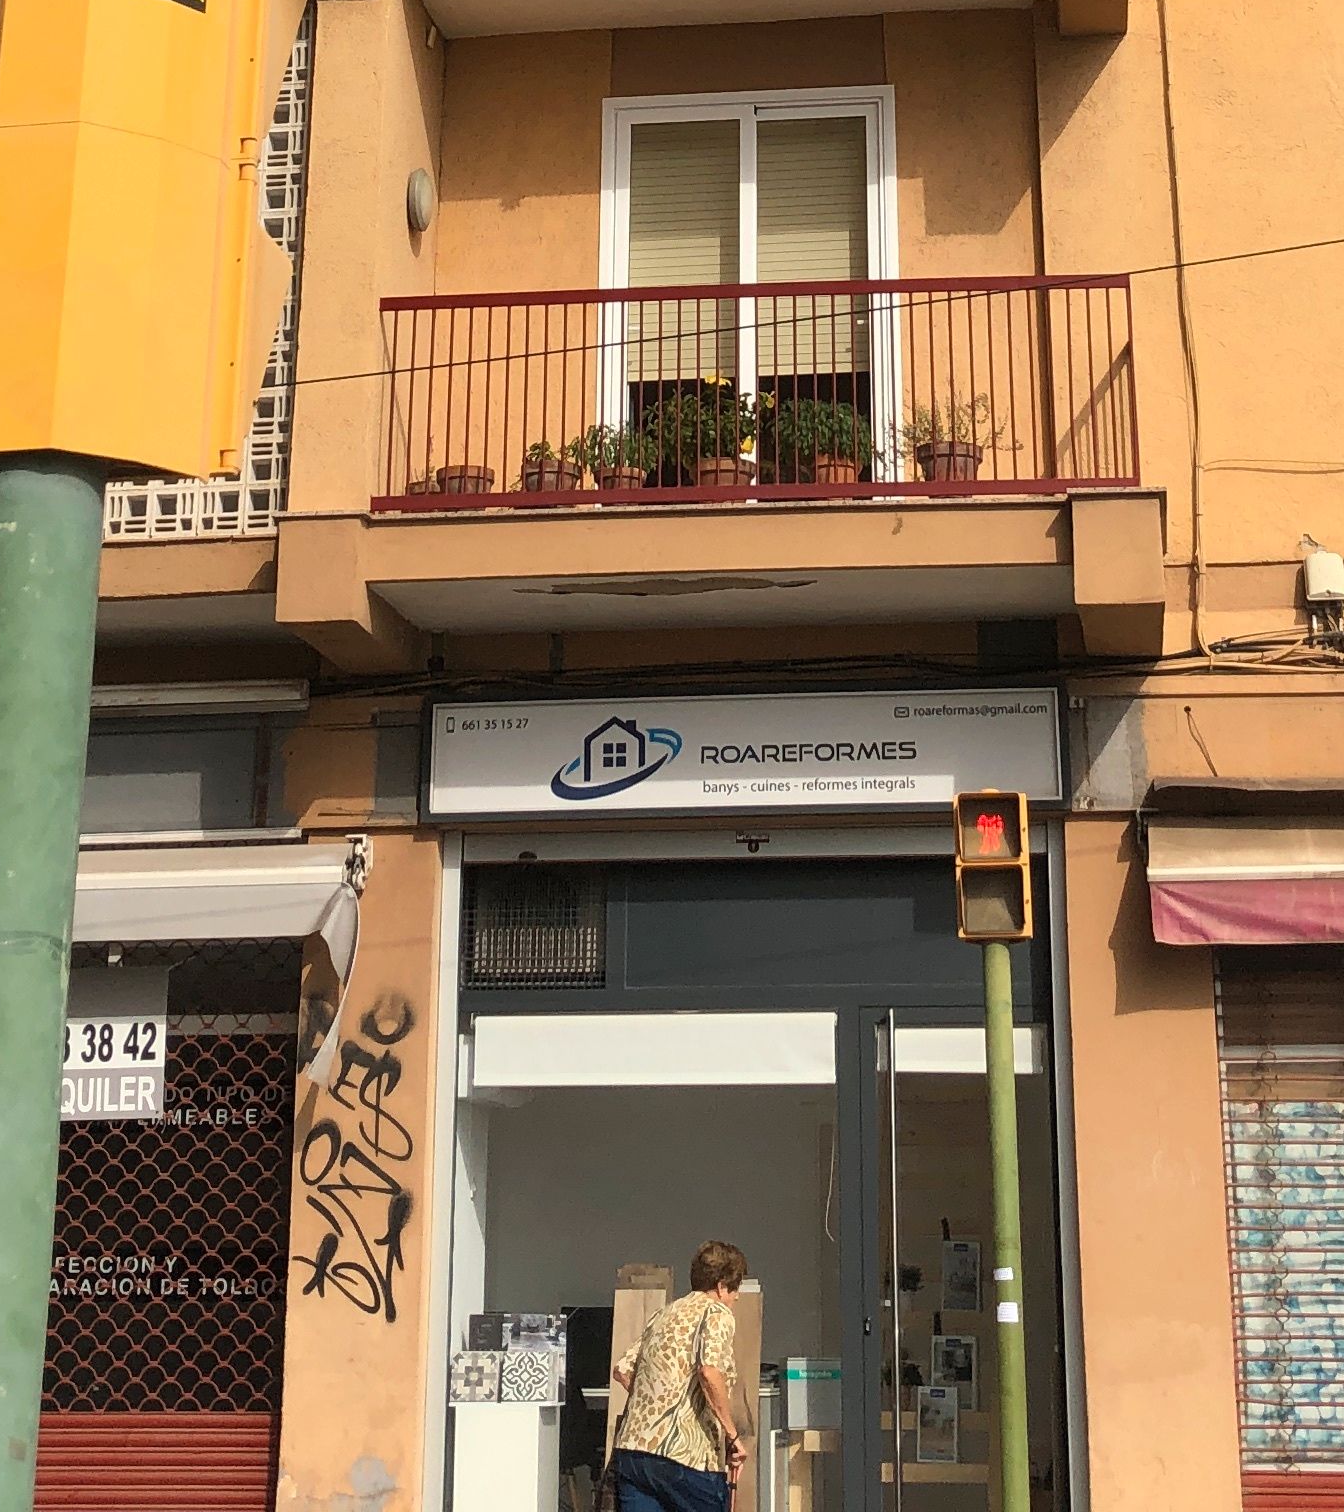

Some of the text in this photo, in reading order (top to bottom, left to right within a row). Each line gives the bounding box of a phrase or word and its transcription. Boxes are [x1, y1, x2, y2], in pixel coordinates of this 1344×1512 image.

[913, 703, 1048, 717] roareformas@gmail.com
[461, 717, 529, 731] 661 35 15 27
[700, 741, 918, 765] ROAREFORMES
[702, 780, 740, 796] banys
[750, 779, 791, 792] cuines
[802, 777, 857, 792] reformes
[861, 776, 916, 793] integrals
[81, 1023, 114, 1063] 38
[123, 1022, 157, 1062] 42
[164, 1255, 178, 1273] Y
[160, 1277, 189, 1296] DE
